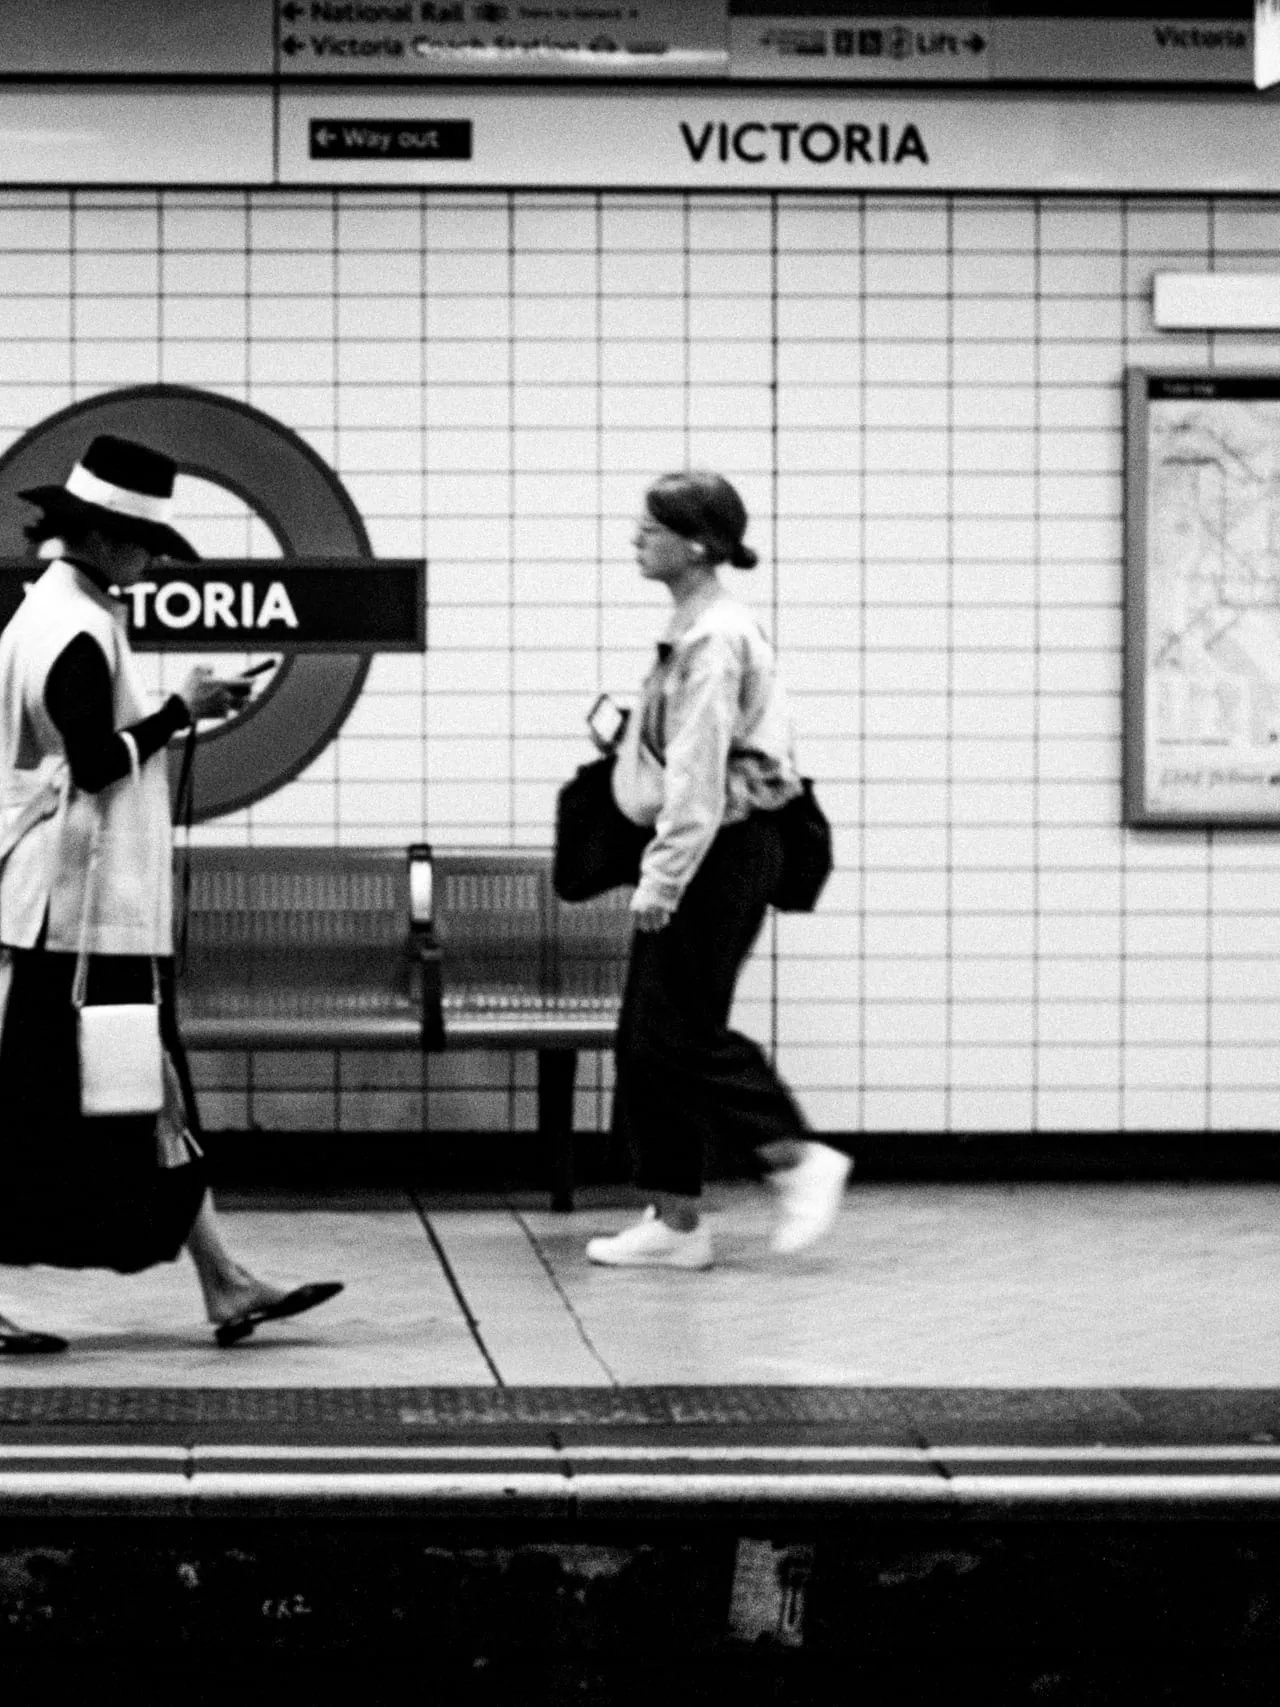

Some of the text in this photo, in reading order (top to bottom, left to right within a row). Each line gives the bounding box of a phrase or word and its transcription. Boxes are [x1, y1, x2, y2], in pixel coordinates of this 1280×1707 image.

[311, 1, 465, 23] National Rail
[310, 35, 404, 57] Victoria
[915, 31, 960, 56] Lift
[1152, 24, 1247, 49] Victoria
[342, 127, 440, 153] Way out
[680, 121, 929, 164] VICTORIA
[23, 581, 298, 629] TORIA
